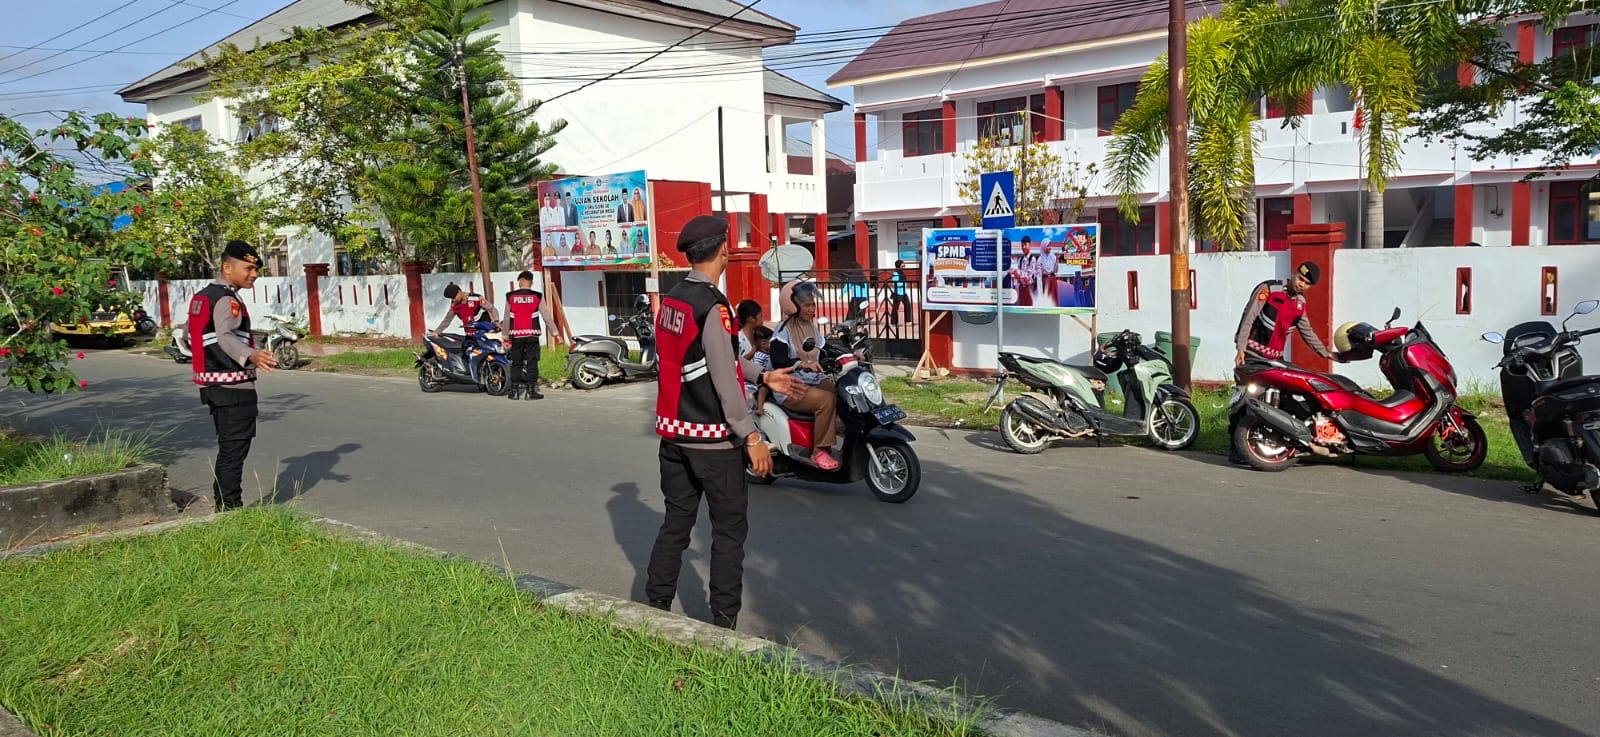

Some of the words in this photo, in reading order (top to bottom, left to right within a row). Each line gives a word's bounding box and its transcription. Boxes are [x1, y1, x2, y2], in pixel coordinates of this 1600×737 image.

[574, 197, 592, 205] UJIAN
[592, 194, 619, 203] SEKOLAH
[937, 245, 966, 258] SPMB
[513, 296, 534, 304] POLISI
[659, 304, 685, 335] POLISI
